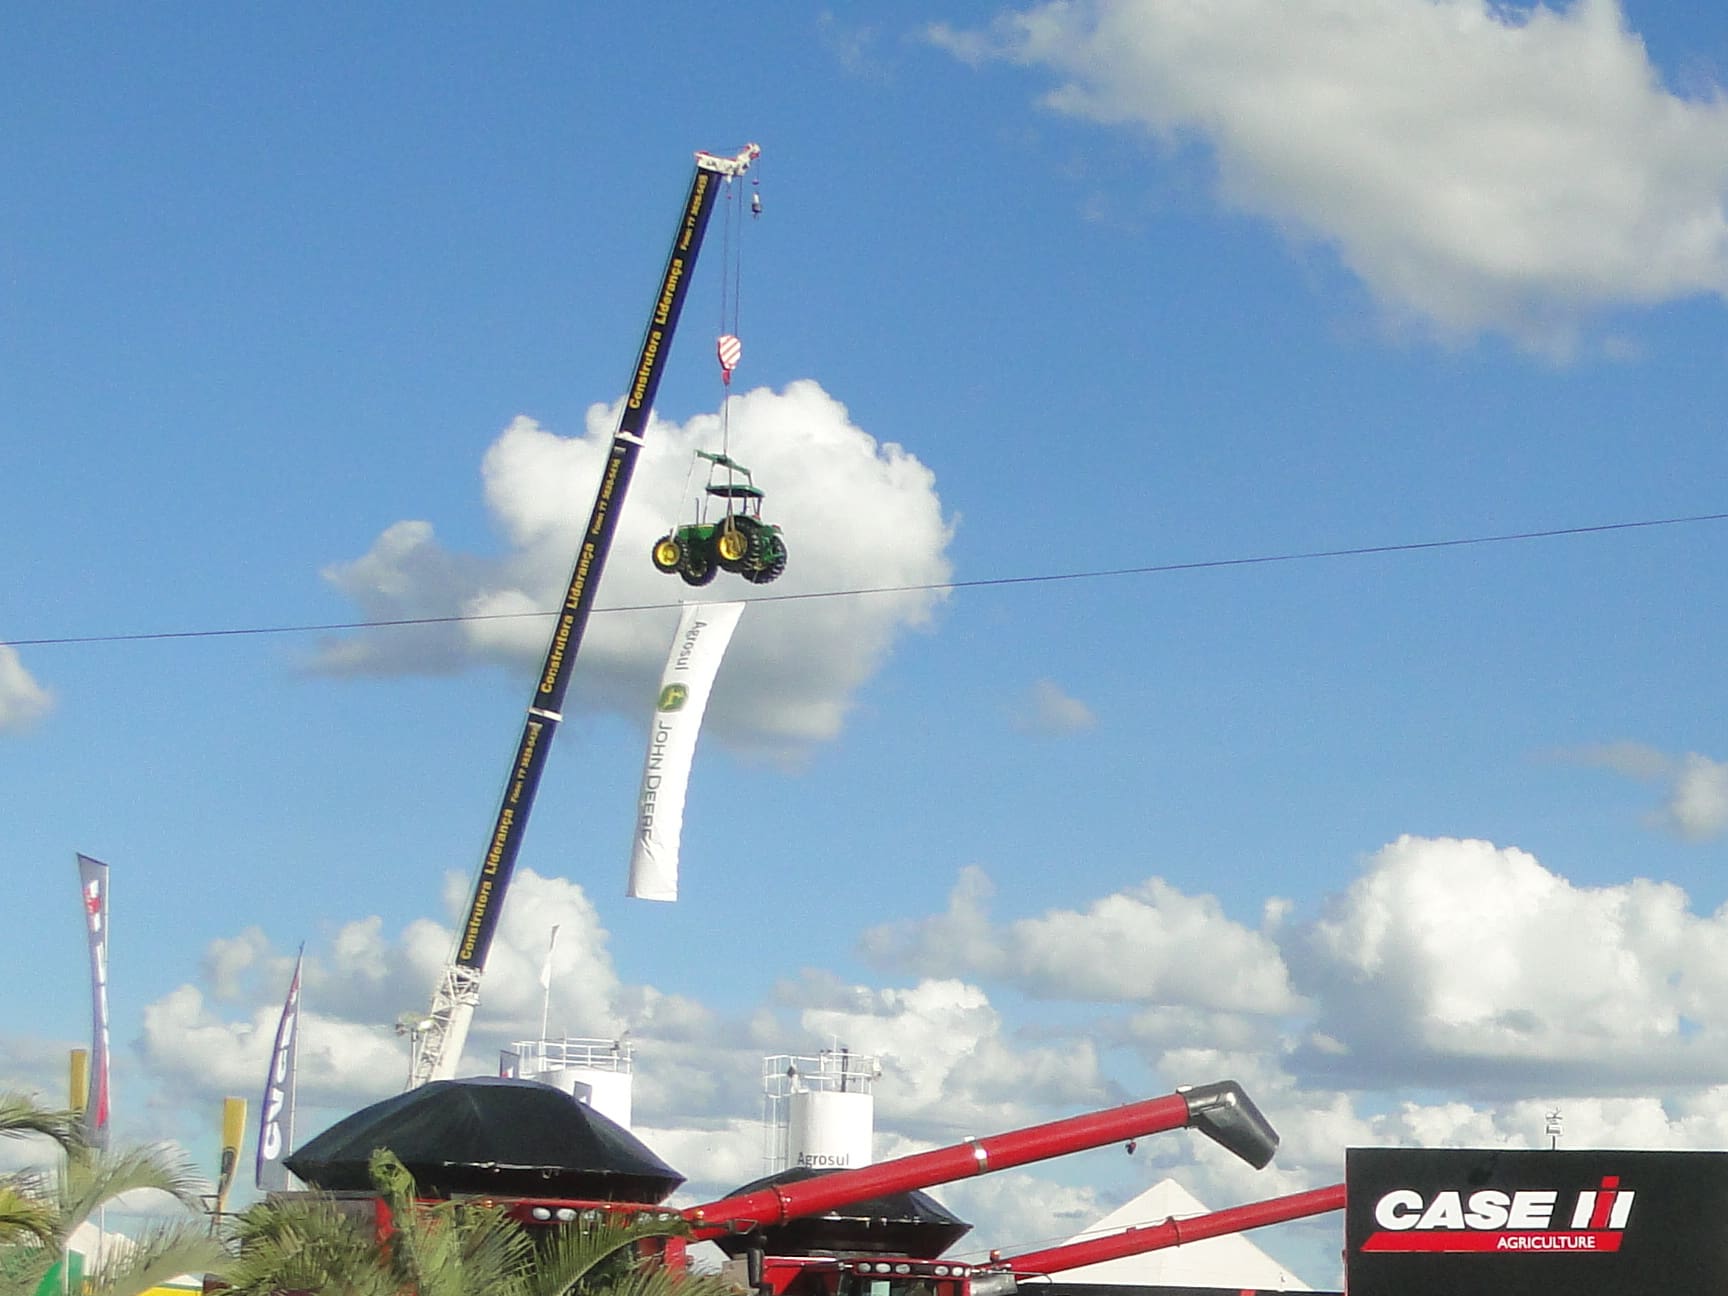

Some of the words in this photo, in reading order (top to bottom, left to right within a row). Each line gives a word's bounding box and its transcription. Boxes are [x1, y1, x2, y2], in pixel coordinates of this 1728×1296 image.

[628, 330, 662, 410] Construtora
[540, 614, 574, 694] Construtora
[675, 619, 708, 671] Agrosul
[649, 719, 673, 770] JOHN
[459, 880, 492, 961] Construtora
[797, 1151, 850, 1169] Agrosul
[1374, 1189, 1558, 1231] CASE
[1496, 1235, 1597, 1250] AGRICULTURE
